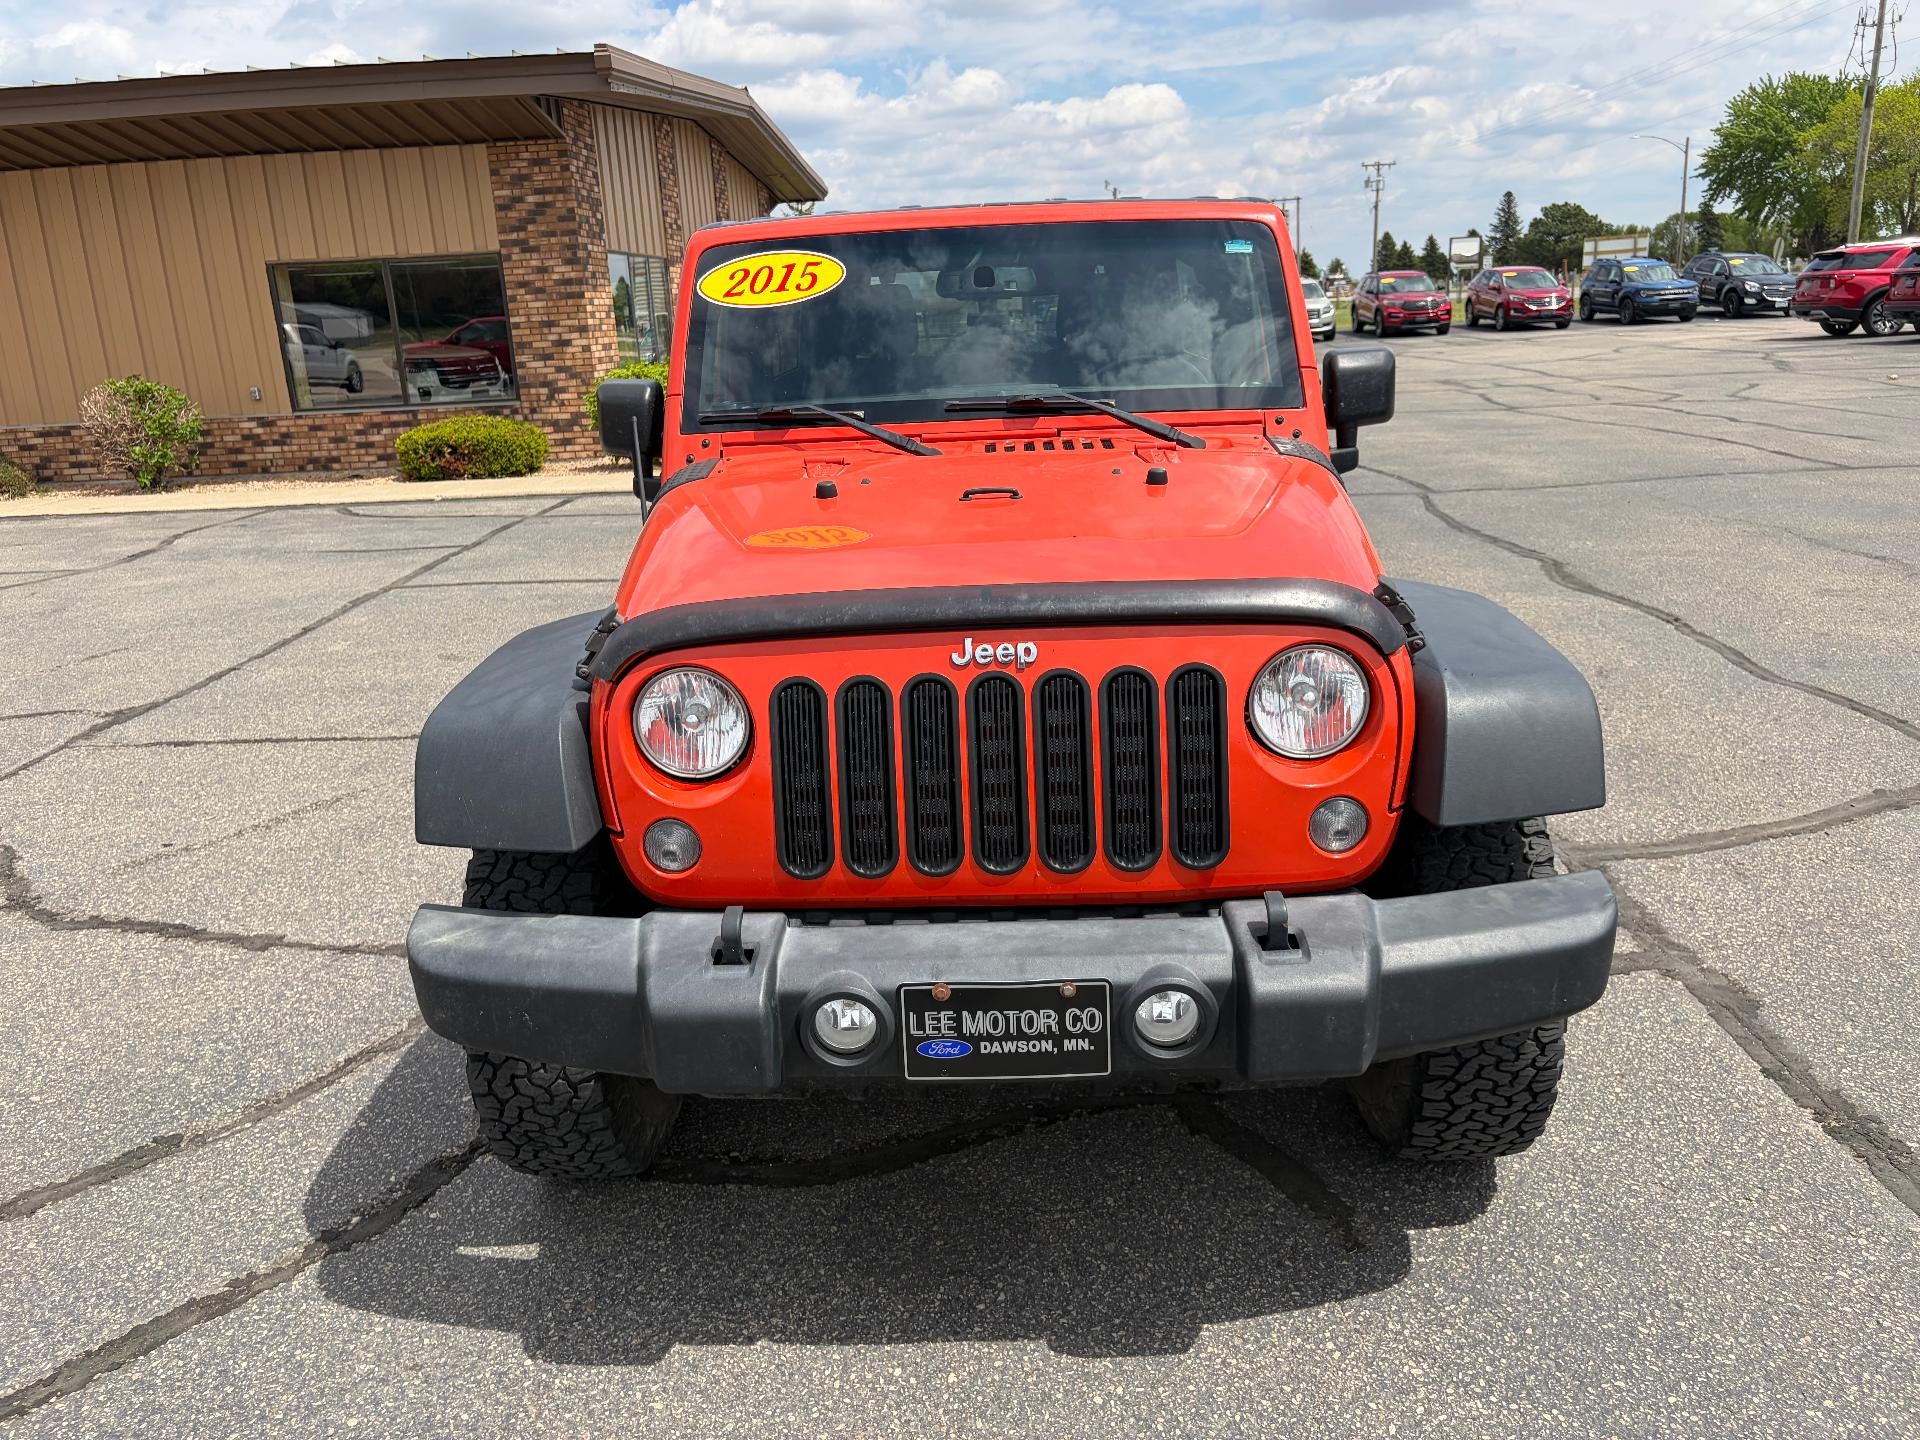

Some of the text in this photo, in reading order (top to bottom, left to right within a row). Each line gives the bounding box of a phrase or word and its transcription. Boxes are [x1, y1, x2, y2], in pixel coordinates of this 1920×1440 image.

[723, 261, 823, 298] 2015
[951, 637, 1038, 669] Jeep
[909, 1007, 1103, 1037] LEE MOTOR CO
[928, 1041, 961, 1055] Ford
[980, 1037, 1095, 1055] DAWSON, MN.
